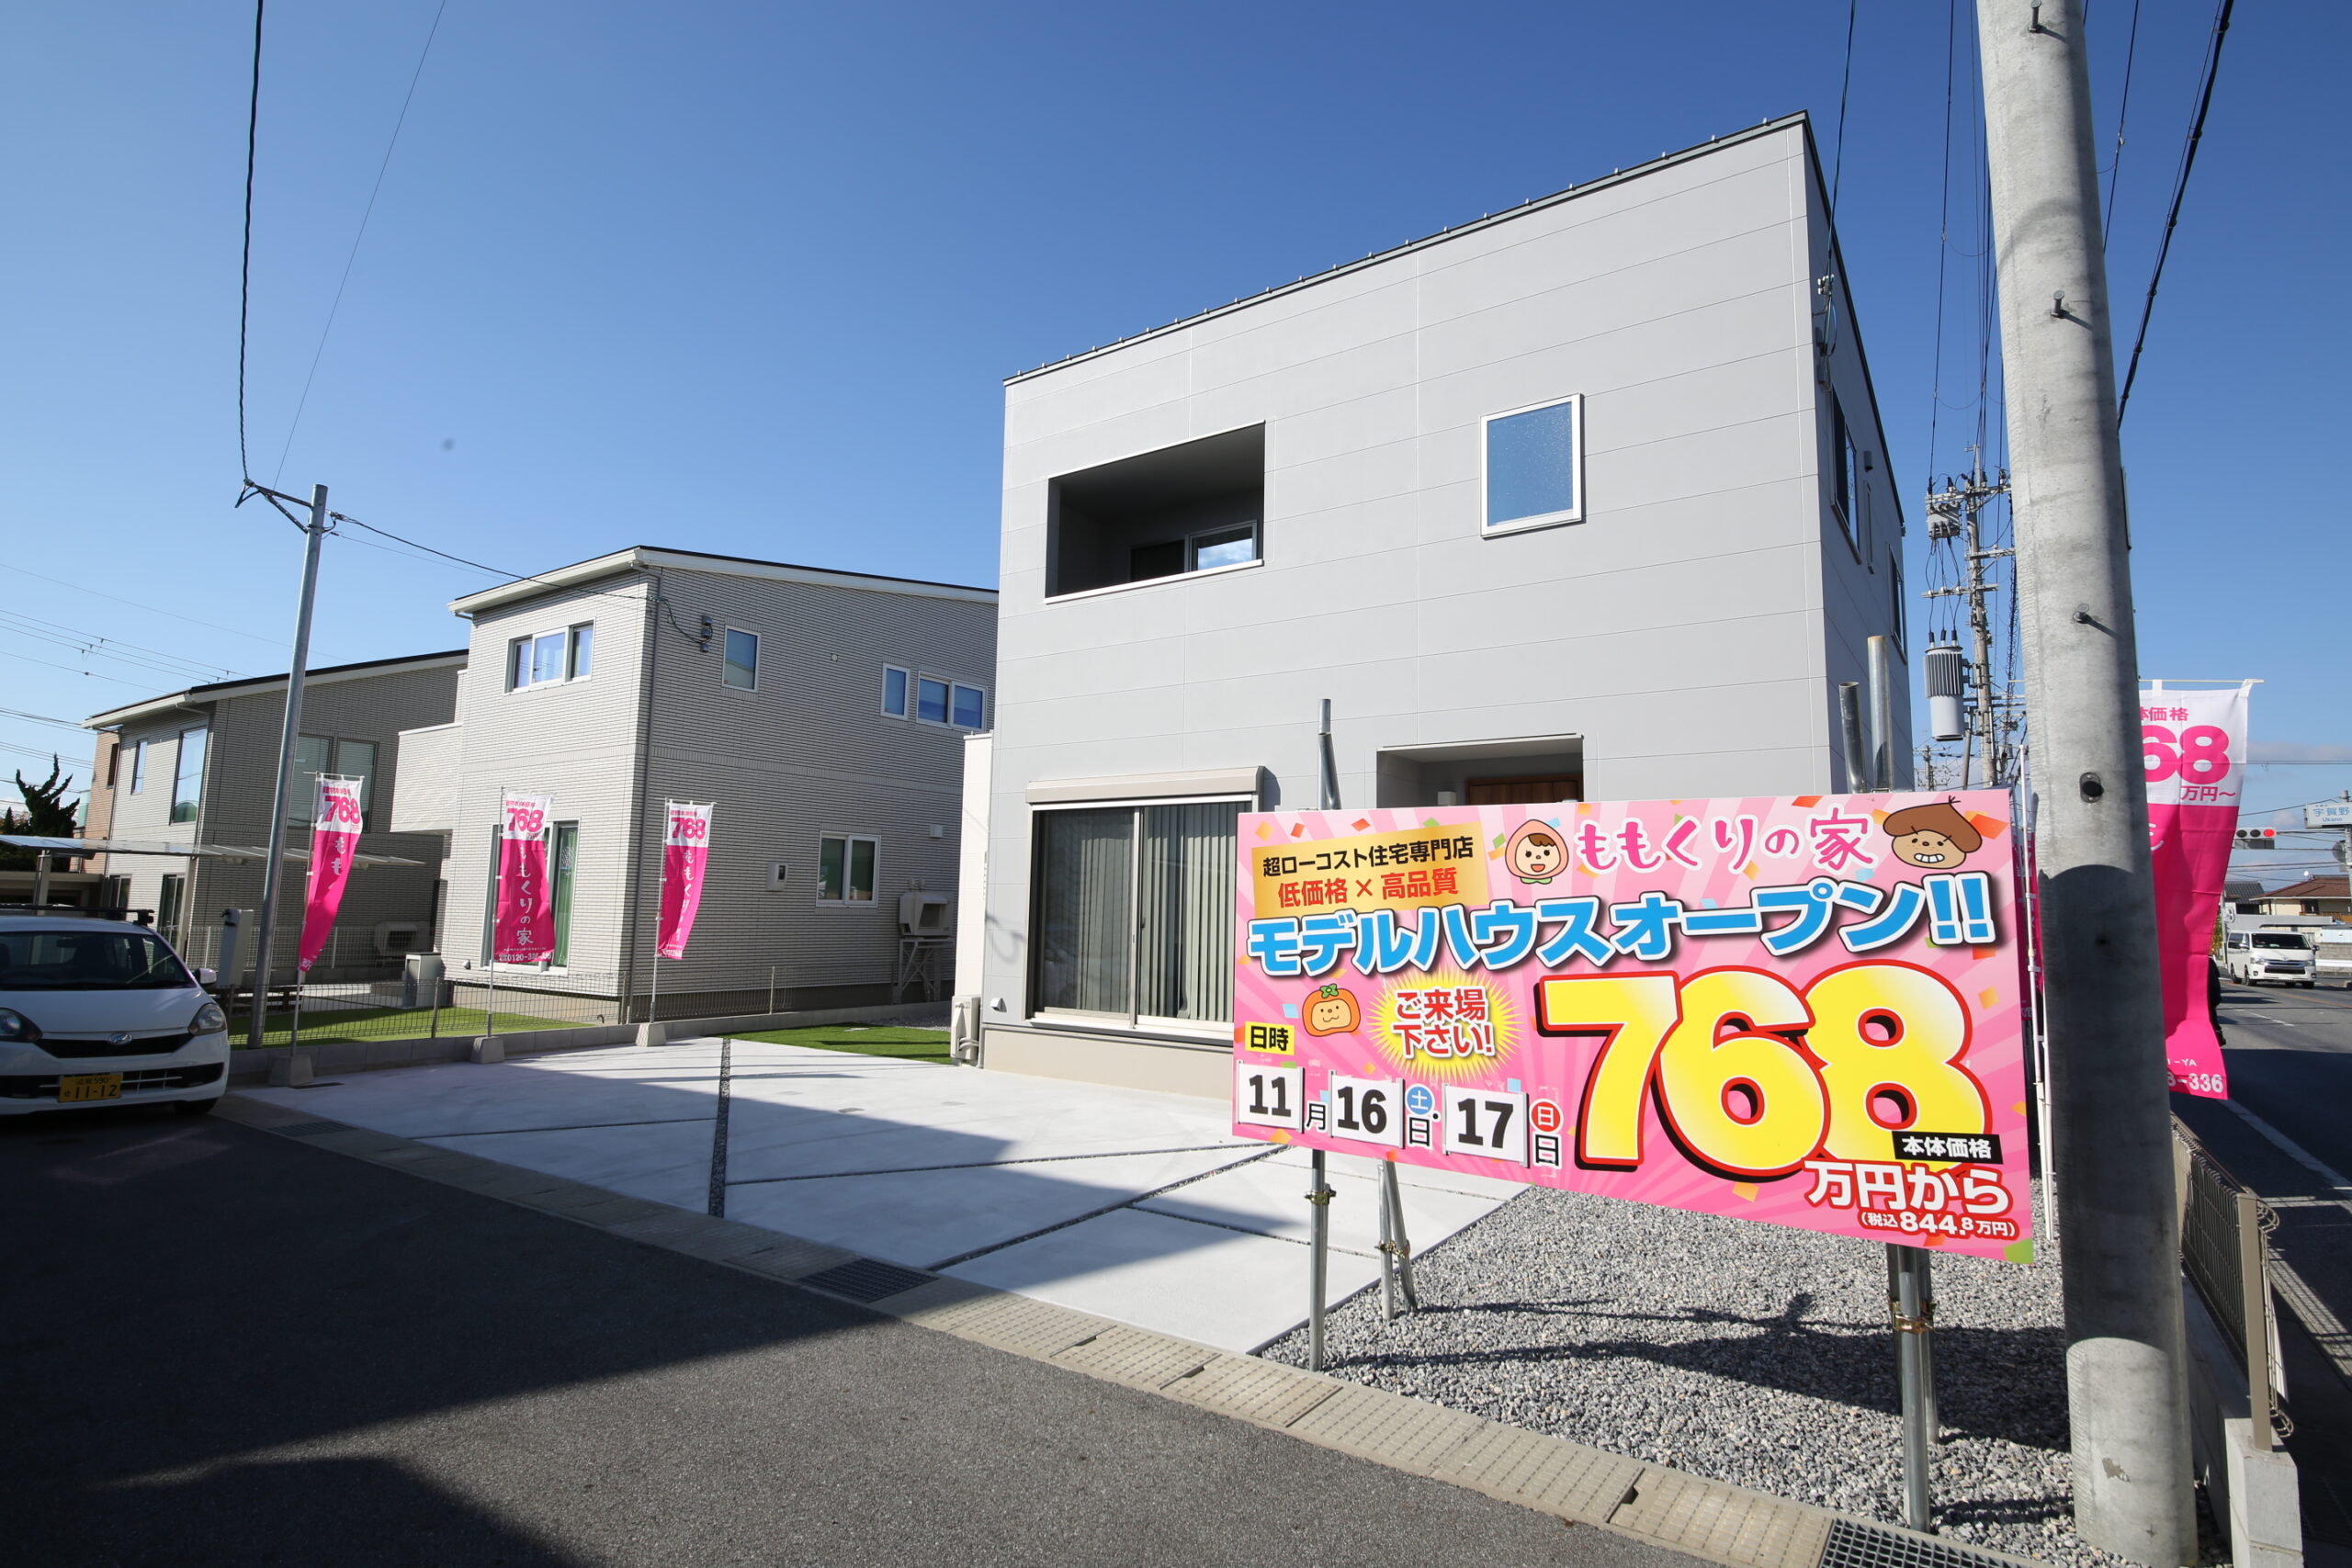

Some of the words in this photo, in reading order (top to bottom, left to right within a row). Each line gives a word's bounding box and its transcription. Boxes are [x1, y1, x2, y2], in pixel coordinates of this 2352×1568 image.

[323, 795, 361, 825] 768
[506, 807, 544, 833] 768
[671, 817, 707, 840] 768
[1577, 807, 1875, 872] ももくりの家
[1262, 836, 1475, 877] 超ローコスト住宅専門店
[1395, 987, 1487, 1021] ご来場
[1250, 1025, 1289, 1051] 日時
[1393, 1024, 1493, 1056] 下さい!
[1538, 959, 1992, 1179] 768
[75, 1084, 118, 1099] 11-12
[1249, 1075, 1292, 1117] 11
[1306, 1103, 1326, 1130] 月
[1337, 1086, 1387, 1134] 16
[1409, 1117, 1430, 1146] 日
[1457, 1098, 1514, 1149] 17
[1535, 1134, 1559, 1167] 日
[1902, 1136, 1992, 1159] 本体価格
[1803, 1160, 2009, 1214] 万円から
